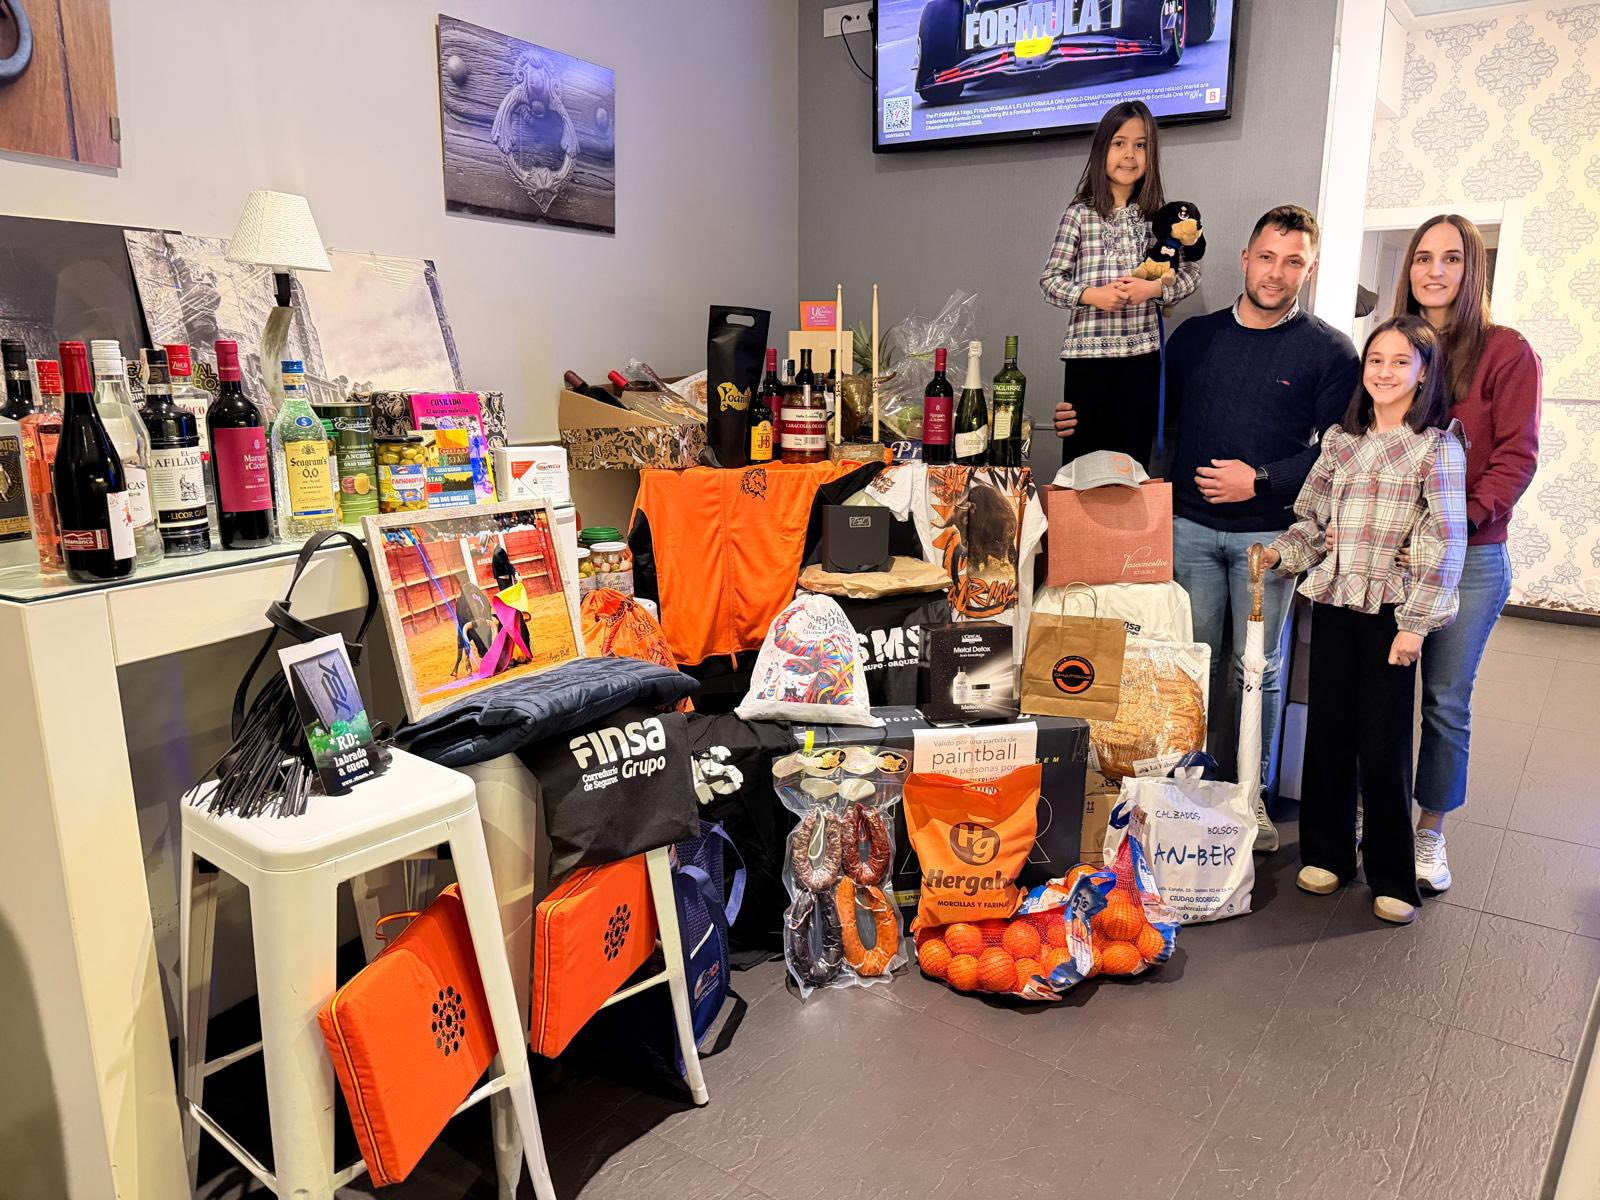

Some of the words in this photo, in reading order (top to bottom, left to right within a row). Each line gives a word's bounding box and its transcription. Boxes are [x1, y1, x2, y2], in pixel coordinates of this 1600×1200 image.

[965, 0, 1102, 49] FORMULA
[1109, 0, 1122, 28] 1
[1123, 89, 1141, 97] GRAND
[430, 398, 462, 406] CONRADO
[0, 439, 19, 452] ATER
[890, 441, 923, 459] Pr
[290, 457, 328, 467] Seagram's
[127, 480, 146, 491] CAS
[171, 511, 194, 520] LICOR
[1123, 621, 1142, 632] nsa
[953, 646, 970, 654] Metal
[971, 645, 991, 653] Detox
[888, 658, 919, 668] ORQUES
[933, 738, 955, 747] Válido
[955, 739, 967, 747] por
[983, 736, 1007, 745] partida
[1007, 735, 1017, 743] de
[333, 747, 367, 768] labrado
[931, 742, 1017, 769] paintball
[1035, 756, 1060, 764] REM
[337, 767, 346, 777] a
[346, 758, 370, 773] cuero
[581, 766, 618, 784] Correduría
[621, 755, 666, 779] Grupo
[960, 765, 998, 776] personas
[1000, 764, 1016, 775] por
[583, 782, 594, 792] de
[593, 776, 619, 790] Seguros
[1155, 810, 1201, 820] CALZADOS
[1207, 826, 1239, 835] BOLSOS
[1154, 842, 1236, 867] AN-BER
[937, 900, 976, 908] MORCILLAS
[984, 900, 1010, 909] FARINA
[1195, 895, 1221, 903] RODRIGO
